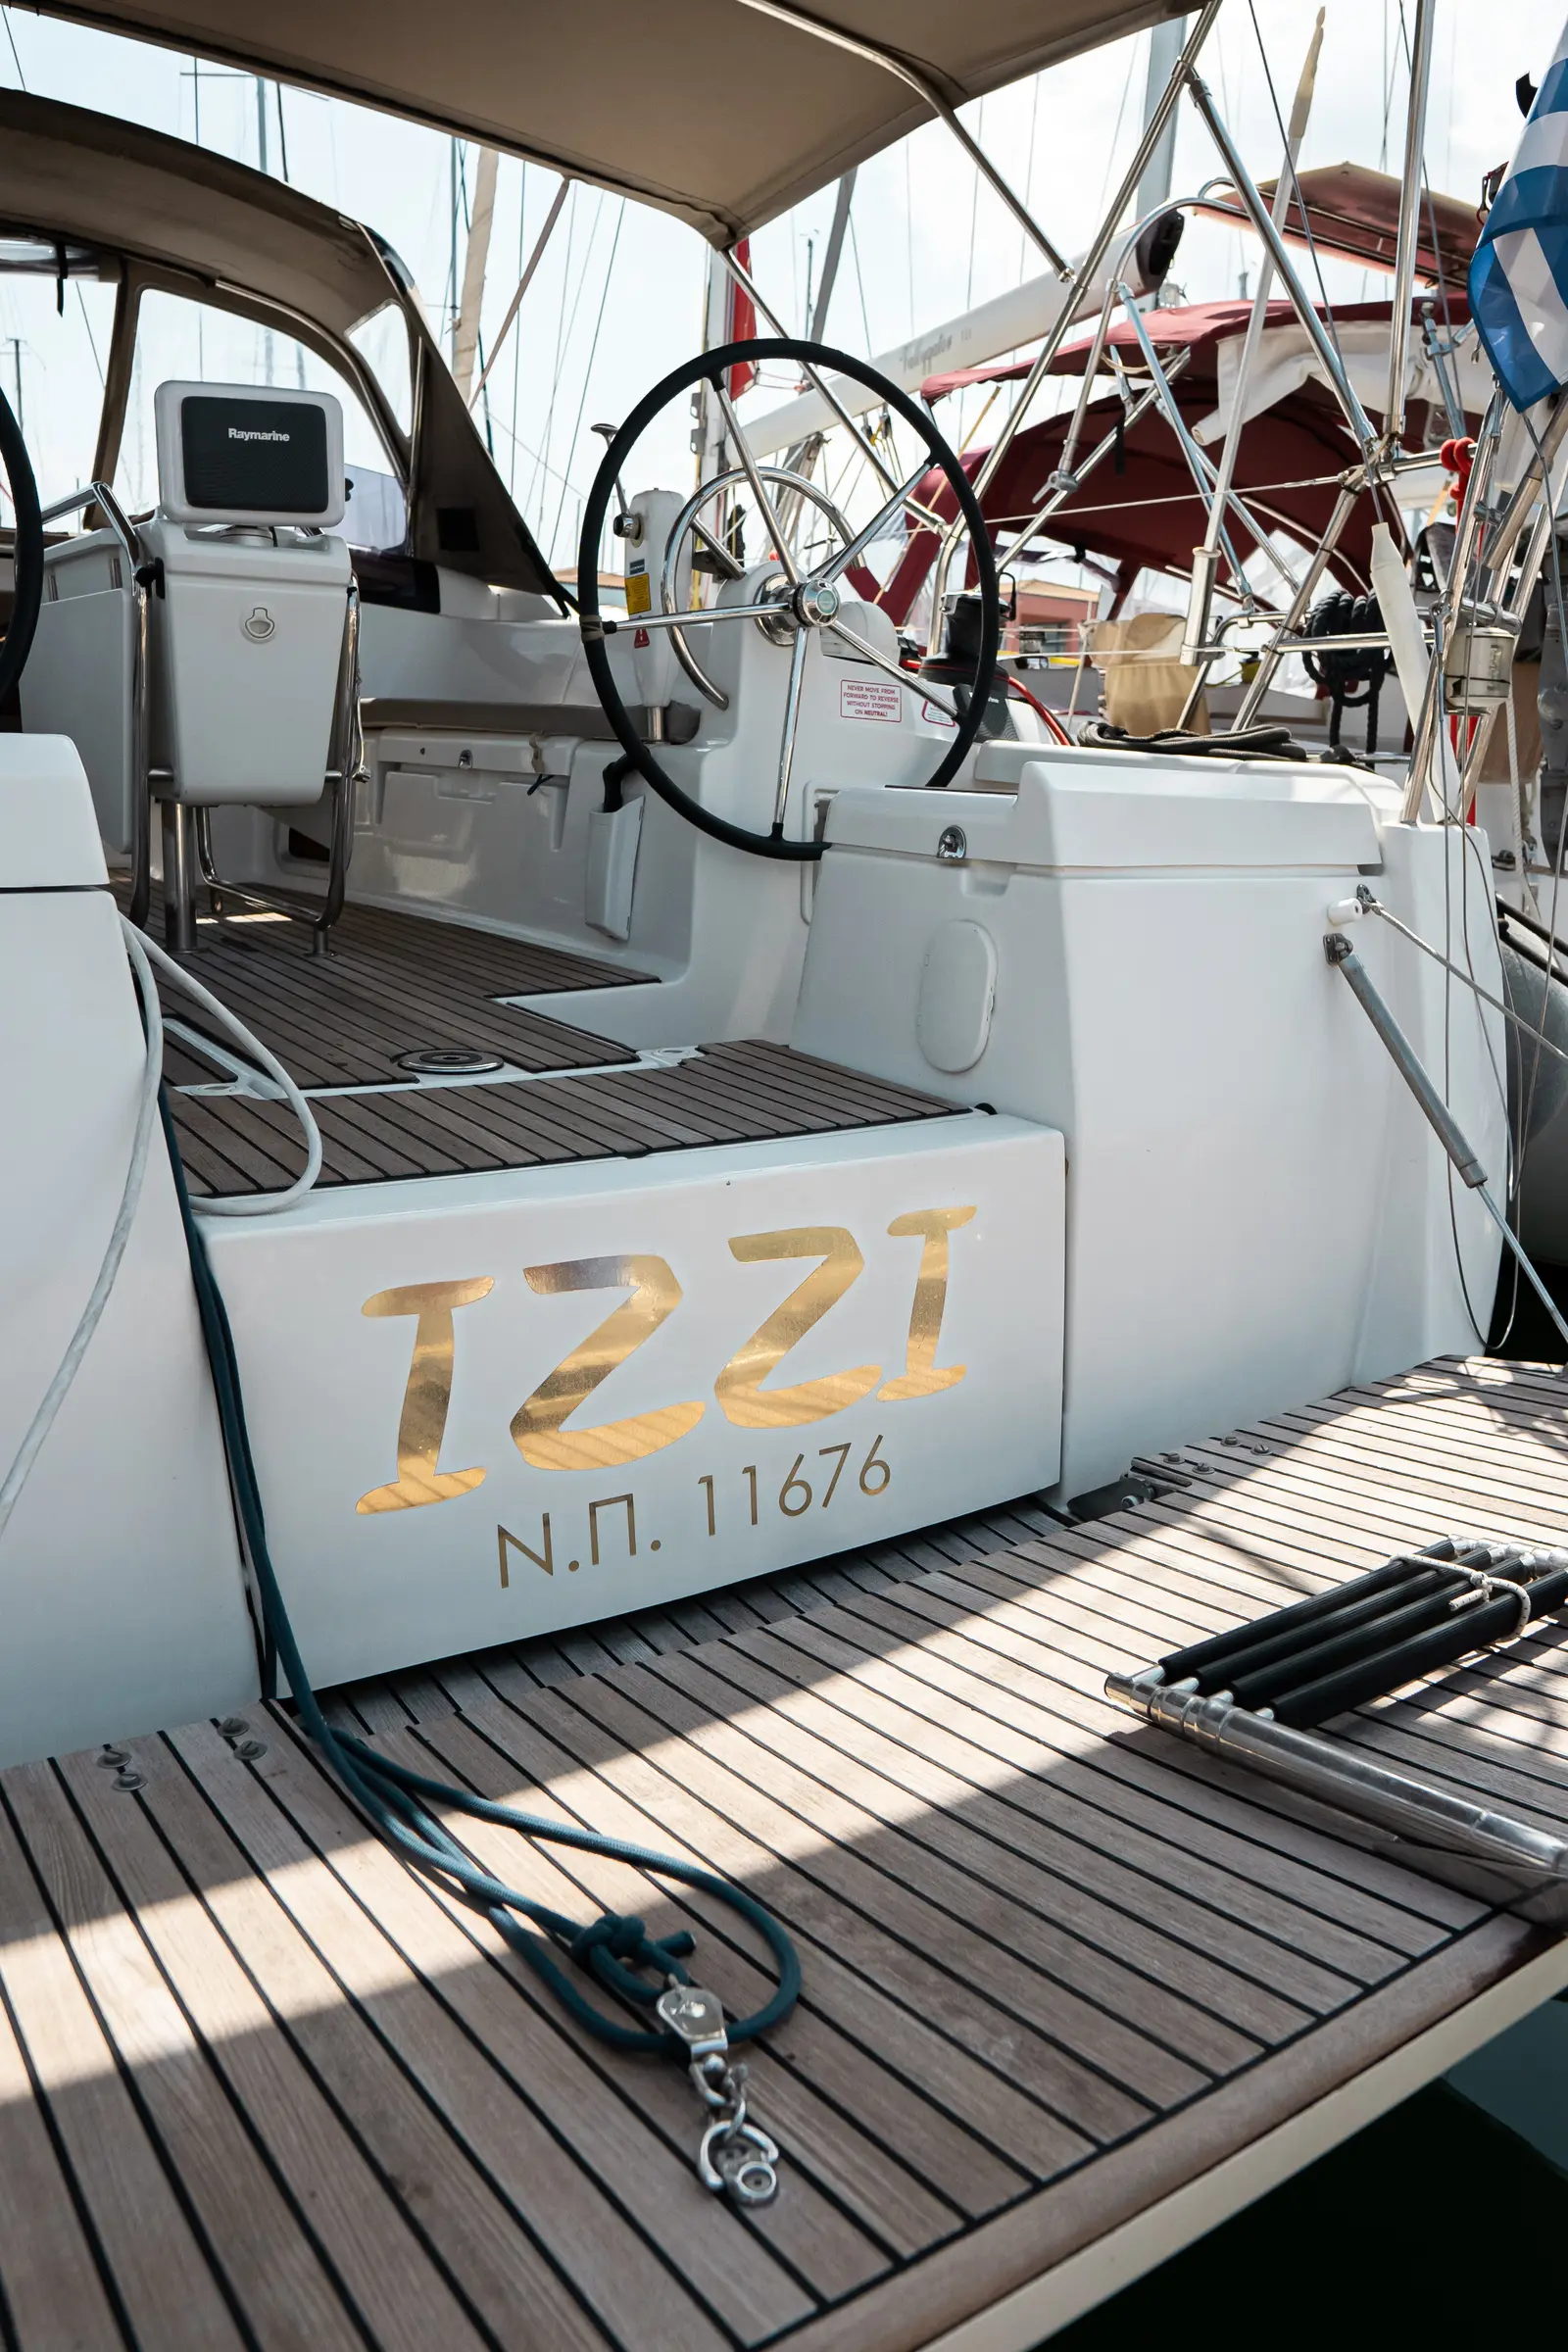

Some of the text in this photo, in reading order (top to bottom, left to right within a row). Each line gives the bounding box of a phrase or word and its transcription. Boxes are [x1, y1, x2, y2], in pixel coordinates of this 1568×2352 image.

[227, 427, 291, 442] Raymarine
[871, 702, 896, 710] STOPPING
[878, 695, 900, 704] REVERSE
[355, 1204, 977, 1515] IZZI
[698, 1434, 892, 1538] 11676
